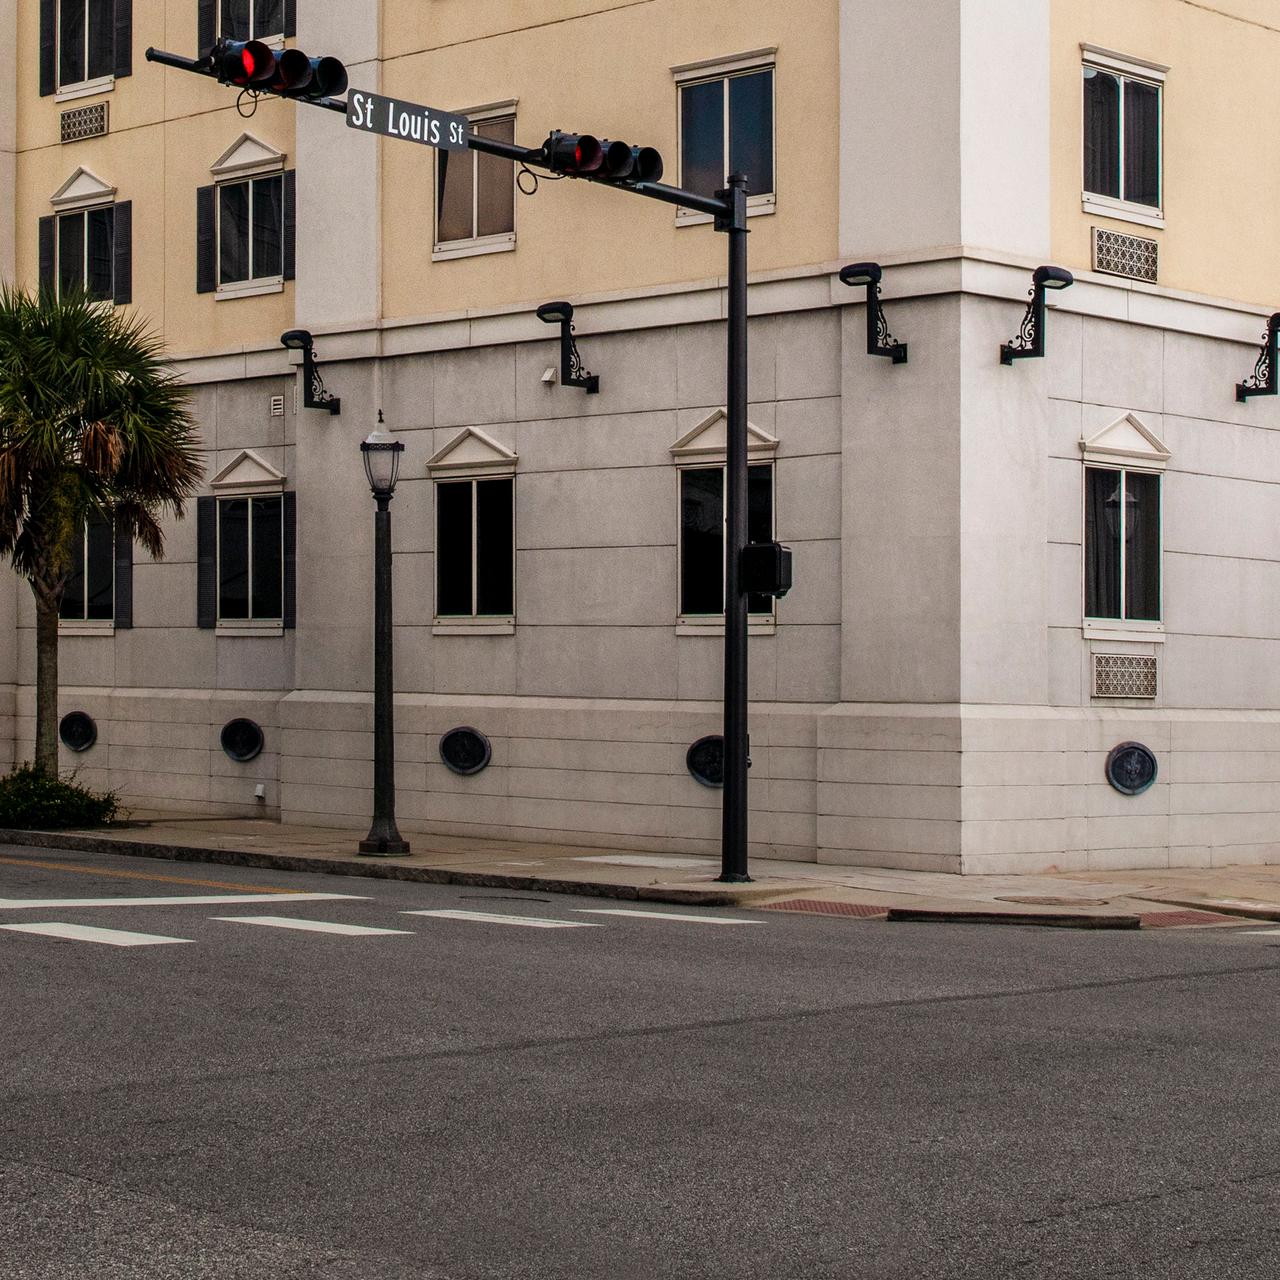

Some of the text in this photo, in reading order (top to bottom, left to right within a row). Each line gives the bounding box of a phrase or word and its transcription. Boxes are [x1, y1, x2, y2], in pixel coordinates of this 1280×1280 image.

[352, 93, 464, 145] St Louis St
